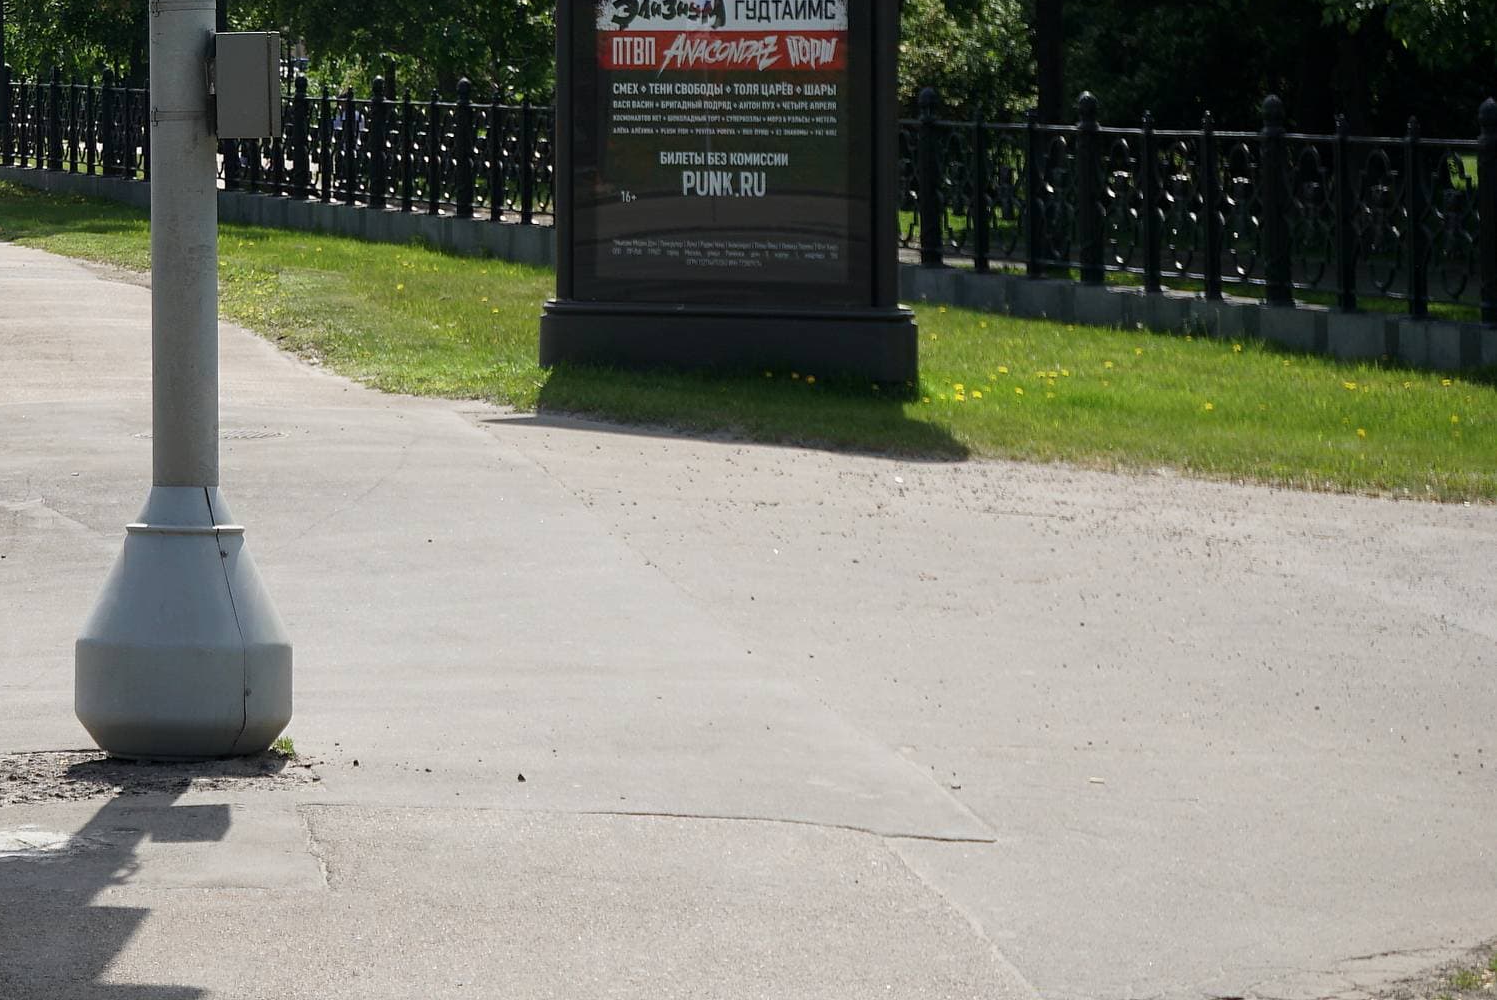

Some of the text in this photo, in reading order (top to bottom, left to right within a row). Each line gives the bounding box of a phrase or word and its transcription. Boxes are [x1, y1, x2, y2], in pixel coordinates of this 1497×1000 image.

[612, 36, 656, 65] ПТВП
[613, 81, 837, 97] СМЕХ ТЕНИ СВОБОДЫ ТОЛЯ ЦАРЁВ ШАРЫ
[613, 100, 631, 109] ВАСЯ
[703, 101, 732, 111] ПОДРЯД
[739, 101, 760, 110] АНТОН
[660, 151, 789, 166] БИЛЕТЫ БЕЗ КОМИССИИ
[682, 170, 766, 197] PUNK.RU
[621, 191, 637, 202] 16+
